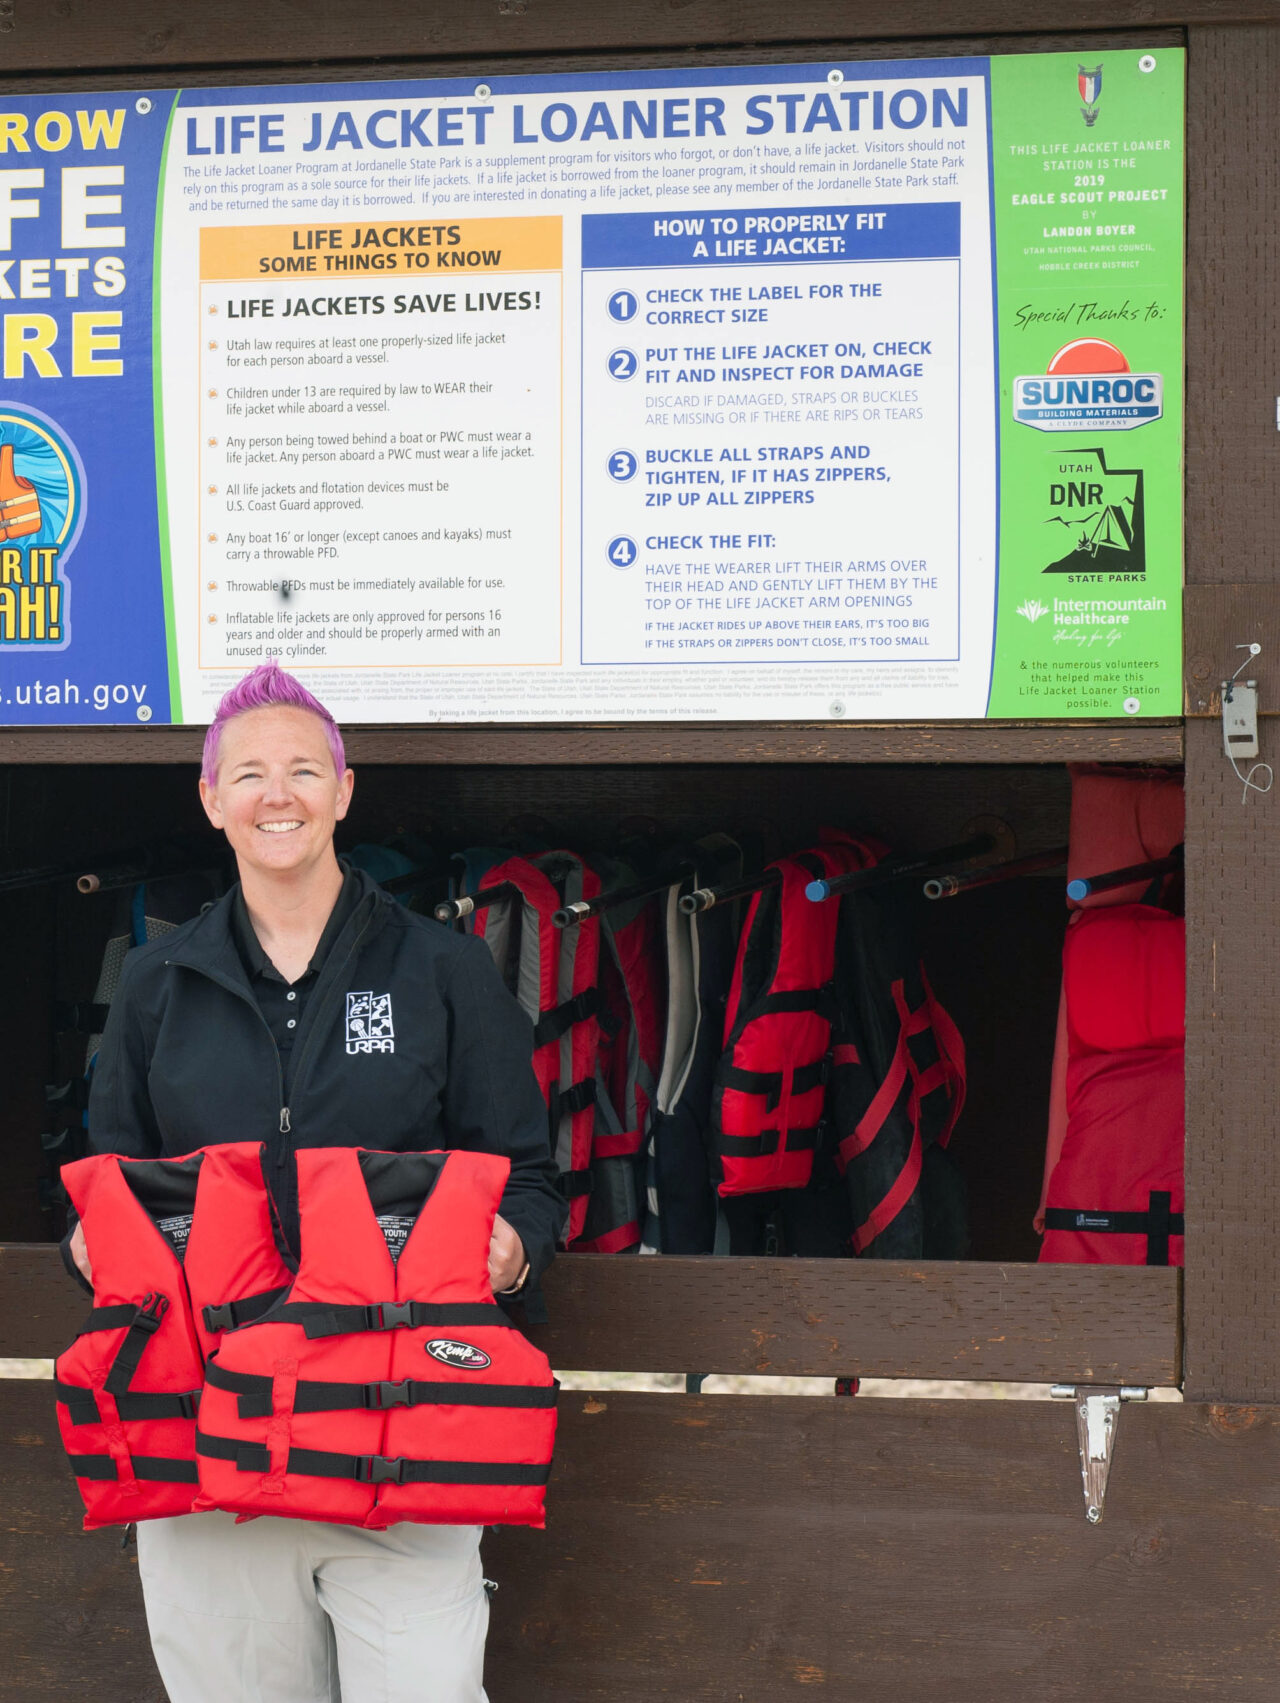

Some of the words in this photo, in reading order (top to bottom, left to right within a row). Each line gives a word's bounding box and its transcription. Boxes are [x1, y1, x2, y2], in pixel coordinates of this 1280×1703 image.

[187, 114, 284, 155] LIFE
[303, 106, 494, 151] JACKET
[513, 97, 726, 143] LOANER
[745, 88, 967, 135] STATION
[1009, 144, 1037, 155] THIS
[1042, 143, 1068, 154] LIFE
[1073, 141, 1118, 153] JACKET
[1123, 139, 1170, 151] LOANER
[1042, 159, 1092, 171] STATION
[1098, 158, 1109, 168] IS
[1112, 157, 1136, 167] THE
[1074, 174, 1104, 186] 2019
[1012, 193, 1054, 205] EAGLE
[1060, 191, 1103, 203] SCOUT
[1108, 189, 1167, 201] PROJECT
[1082, 210, 1096, 219] BY
[654, 219, 704, 236] HOW
[710, 217, 737, 234] TO
[744, 214, 849, 233] PROPERLY
[856, 212, 886, 229] FIT
[1043, 226, 1091, 237] LANDON
[1096, 224, 1135, 235] BOYER
[293, 229, 342, 250] LIFE
[351, 225, 460, 248] JACKETS
[692, 241, 708, 257] A
[716, 239, 756, 256] LIFE
[763, 236, 844, 255] JACKET:
[259, 256, 316, 272] SOME
[323, 253, 397, 270] THINGS
[404, 252, 429, 268] TO
[437, 250, 501, 266] KNOW
[646, 288, 703, 303] CHECK
[710, 287, 741, 301] THE
[748, 285, 802, 300] LABEL
[809, 284, 842, 298] FOR
[849, 283, 881, 297] THE
[228, 299, 274, 318] LIFE
[282, 295, 384, 316] JACKETS
[394, 293, 456, 313] SAVE
[465, 291, 540, 311] LIVES!
[615, 295, 628, 318] 1
[646, 309, 725, 324] CORRECT
[731, 308, 768, 322] SIZE
[1014, 303, 1075, 331] Special
[1077, 300, 1138, 325] Thanks
[1144, 301, 1167, 322] to:
[226, 338, 250, 351] Utah
[254, 338, 272, 350] law
[275, 338, 315, 353] requires
[318, 338, 328, 348] at
[332, 336, 356, 348] least
[359, 338, 378, 347] one
[381, 332, 452, 352] properly-sized
[456, 332, 472, 344] life
[474, 332, 505, 347] jacket
[646, 347, 678, 361] PUT
[683, 347, 715, 360] THE
[722, 345, 756, 359] LIFE
[762, 344, 828, 358] JACKET
[834, 343, 865, 358] ON,
[873, 341, 931, 355] CHECK
[613, 354, 631, 377] 2
[646, 369, 670, 383] FIT
[676, 368, 715, 382] AND
[722, 366, 794, 381] INSPECT
[800, 365, 834, 379] FOR
[841, 363, 922, 378] DAMAGE
[1022, 378, 1154, 405] SUNROC
[1086, 408, 1137, 416] MATERIALS
[646, 449, 712, 463] BUCKLE
[719, 448, 751, 461] ALL
[758, 446, 823, 461] STRAPS
[830, 445, 870, 459] AND
[613, 453, 631, 477] 3
[1059, 464, 1092, 472] UTAH
[645, 470, 724, 485] TIGHTEN,
[732, 469, 746, 483] IF
[752, 469, 767, 482] IT
[774, 468, 808, 482] HAS
[815, 467, 890, 481] ZIPPERS,
[645, 493, 671, 506] ZIP
[678, 492, 700, 505] UP
[706, 491, 738, 505] ALL
[744, 490, 814, 504] ZIPPERS
[1050, 482, 1104, 507] DNR
[226, 500, 244, 511] U.S.
[248, 499, 276, 511] Coast
[279, 498, 310, 510] Guard
[313, 497, 363, 512] approved.
[646, 535, 702, 549] CHECK
[709, 535, 741, 548] THE
[748, 534, 775, 547] FIT:
[226, 551, 250, 562] carry
[254, 550, 259, 559] a
[263, 546, 314, 559] throwable
[318, 546, 338, 558] PFD.
[612, 541, 631, 563] 4
[29, 548, 58, 584] IT
[1068, 574, 1102, 582] STATE
[645, 598, 671, 609] TOP
[675, 598, 692, 609] OF
[696, 598, 721, 609] THE
[726, 597, 750, 608] LIFE
[755, 596, 804, 608] JACKET
[808, 596, 839, 607] ARM
[844, 595, 912, 607] OPENINGS
[1054, 597, 1166, 612] Intermountain
[1054, 612, 1129, 624] Healthcare
[226, 642, 262, 656] unused
[265, 646, 282, 660] gas
[286, 643, 326, 658] cylinder.
[1019, 660, 1027, 669] &
[1032, 660, 1047, 669] the
[1052, 659, 1101, 669] numerous
[1105, 659, 1159, 668] volunteers
[1031, 673, 1051, 682] that
[1056, 673, 1089, 683] helped
[1094, 673, 1120, 681] make
[1124, 672, 1143, 681] this
[1019, 685, 1039, 695] Life
[1043, 686, 1076, 695] Jacket
[1082, 686, 1117, 694] Loaner
[1122, 685, 1159, 694] Station
[1066, 698, 1111, 709] possible.
[346, 1039, 394, 1054] URPA
[384, 1229, 407, 1238] YOUTH
[432, 1340, 474, 1360] Kemp
